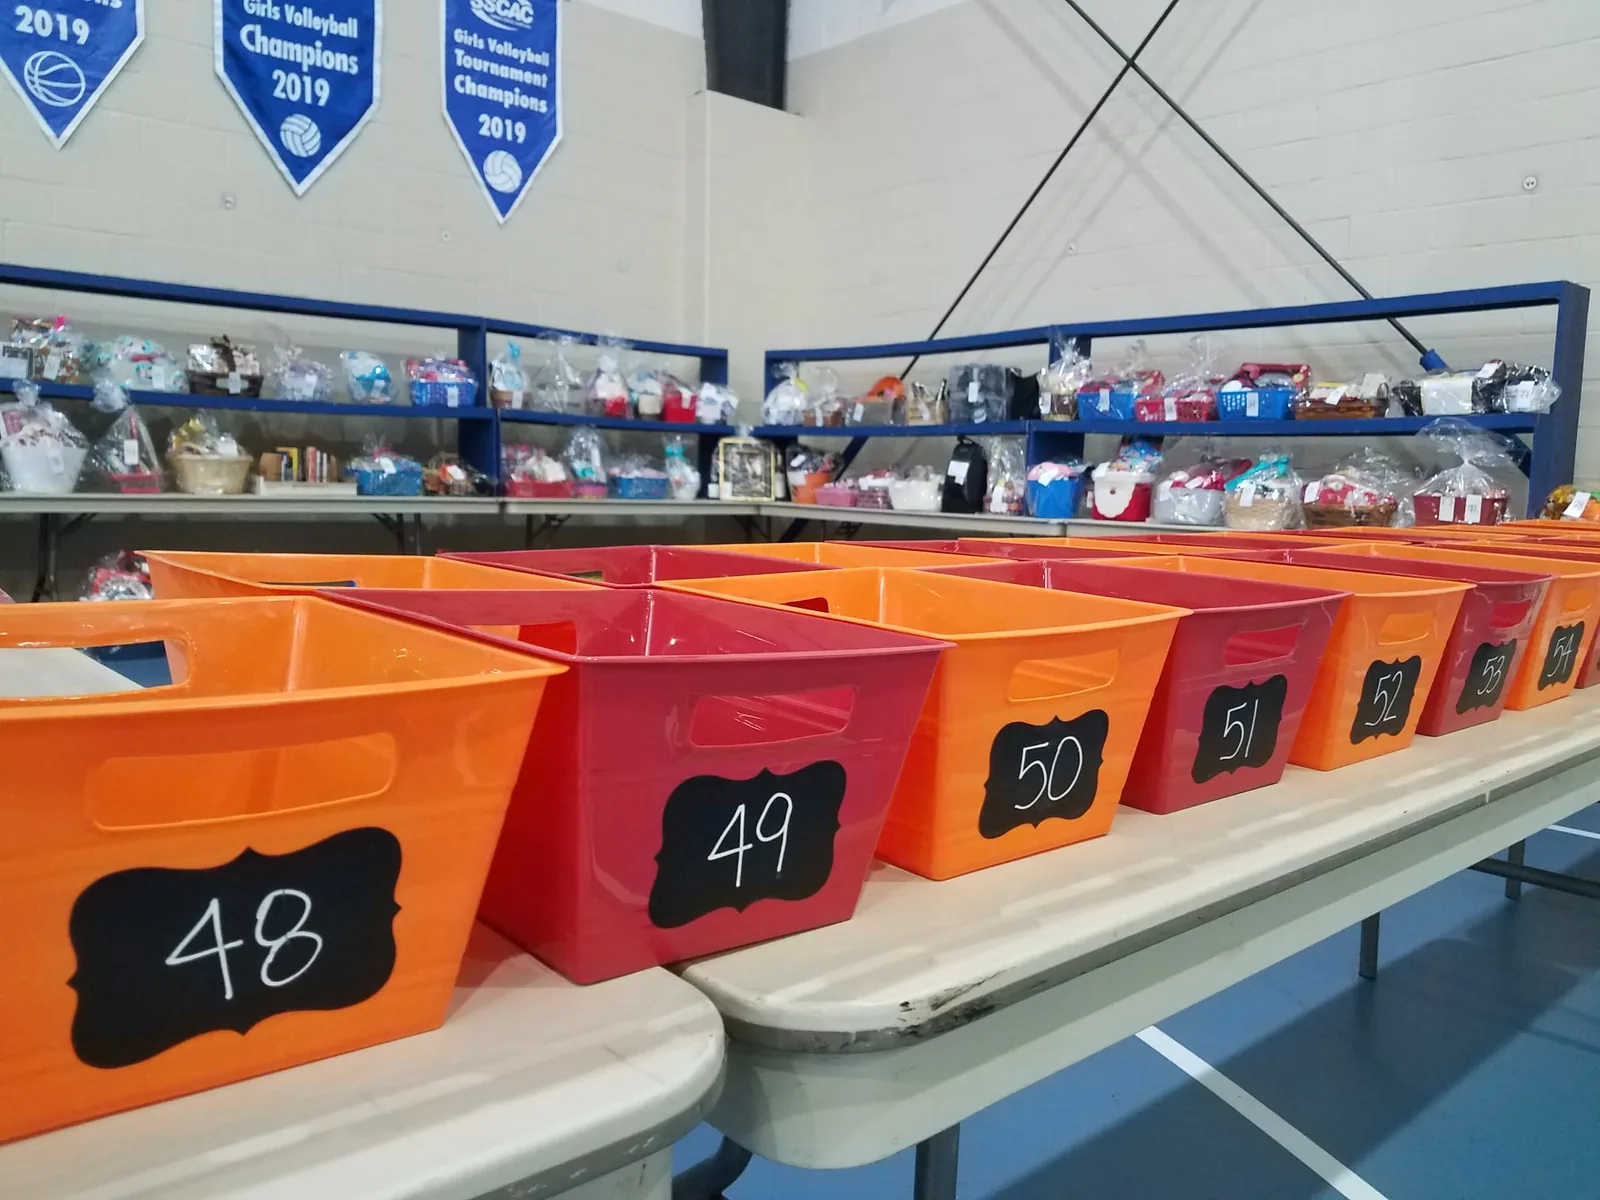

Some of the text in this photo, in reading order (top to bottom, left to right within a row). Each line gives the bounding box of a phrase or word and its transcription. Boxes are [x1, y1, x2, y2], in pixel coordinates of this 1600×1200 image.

[15, 5, 90, 45] 2019
[243, 0, 359, 38] Girls Volleyball
[240, 23, 359, 75] Champions
[453, 28, 550, 67] Girls Volleyball
[272, 68, 330, 107] 2019
[454, 48, 548, 88] Tournament
[454, 74, 548, 113] Champions
[478, 113, 527, 144] 2019
[1477, 655, 1506, 695] 53
[1547, 632, 1575, 678] 54
[1364, 670, 1403, 727] 52
[1219, 698, 1259, 761] 51
[1013, 736, 1083, 810] 50
[707, 792, 793, 888] 49
[165, 888, 323, 1000] 48
